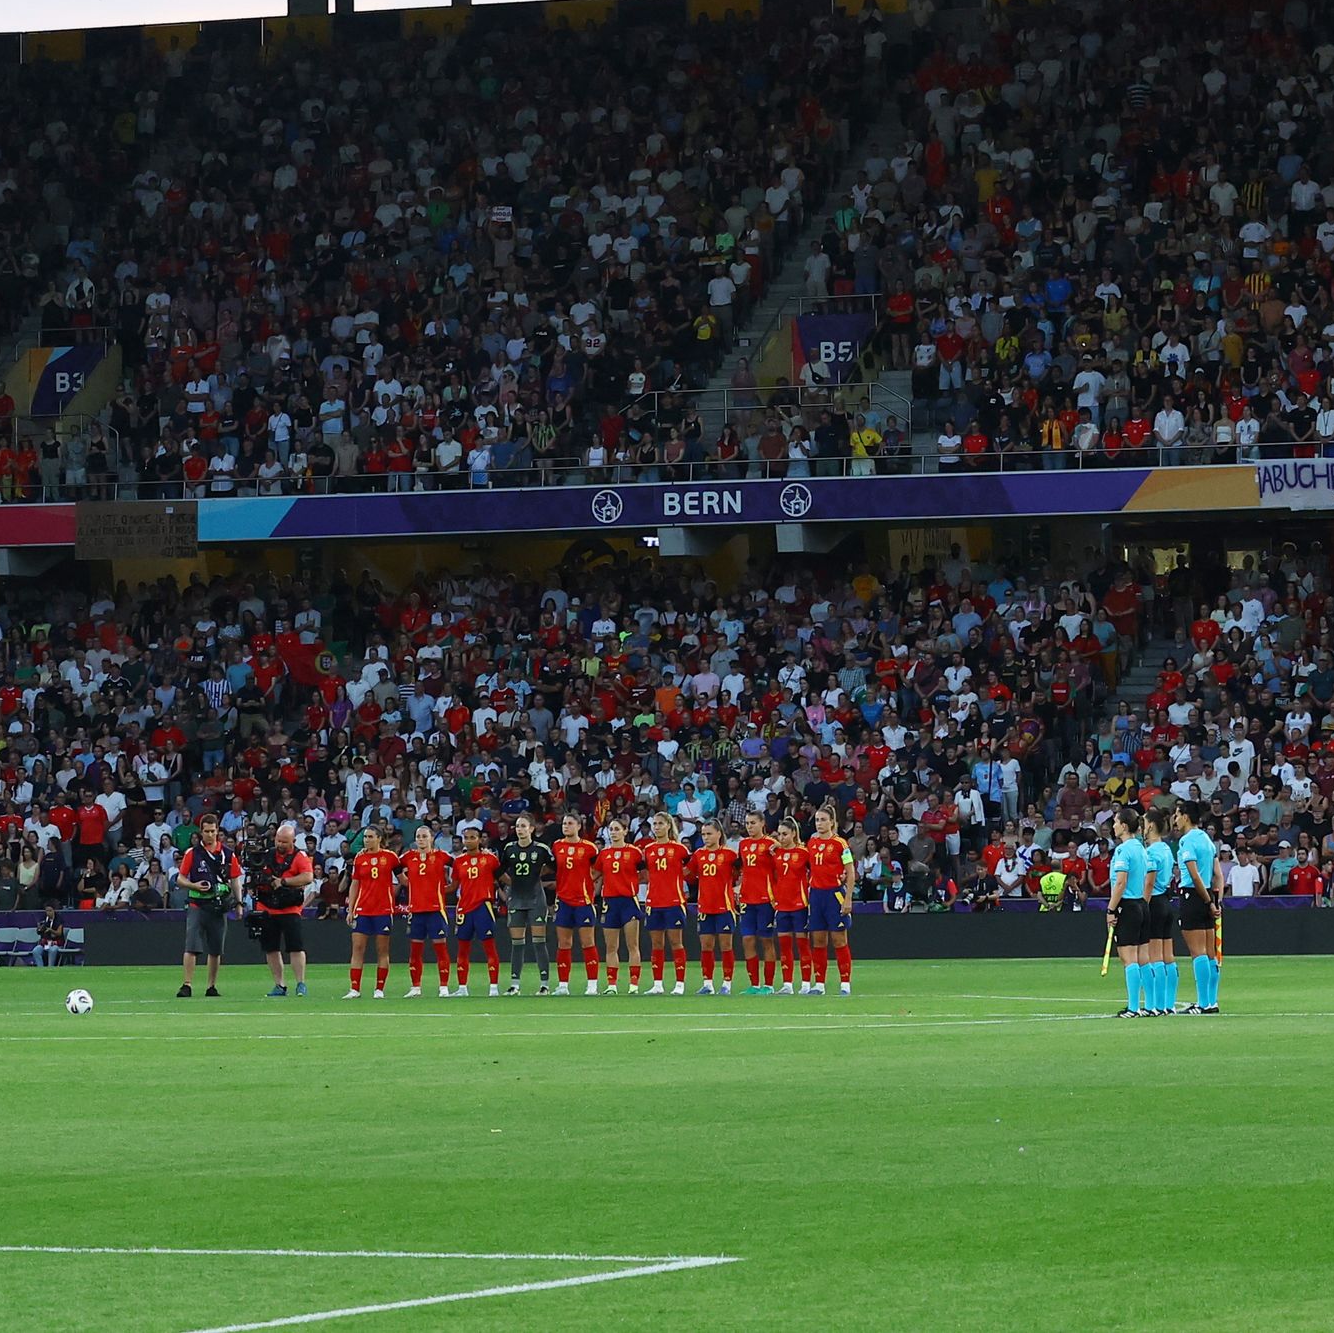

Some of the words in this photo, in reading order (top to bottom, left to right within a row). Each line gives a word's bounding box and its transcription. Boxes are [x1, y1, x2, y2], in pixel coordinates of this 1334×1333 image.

[819, 341, 854, 363] B5
[55, 371, 84, 393] B3
[663, 490, 742, 516] BERN
[565, 857, 573, 870] 5
[654, 858, 667, 871] 14
[745, 853, 756, 866] 12
[814, 852, 823, 865] 11
[370, 866, 379, 879] 8
[418, 862, 427, 876] 2
[466, 866, 479, 879] 19
[515, 863, 530, 876] 23
[612, 861, 621, 873] 9
[702, 864, 717, 876] 20
[782, 862, 789, 875] 7
